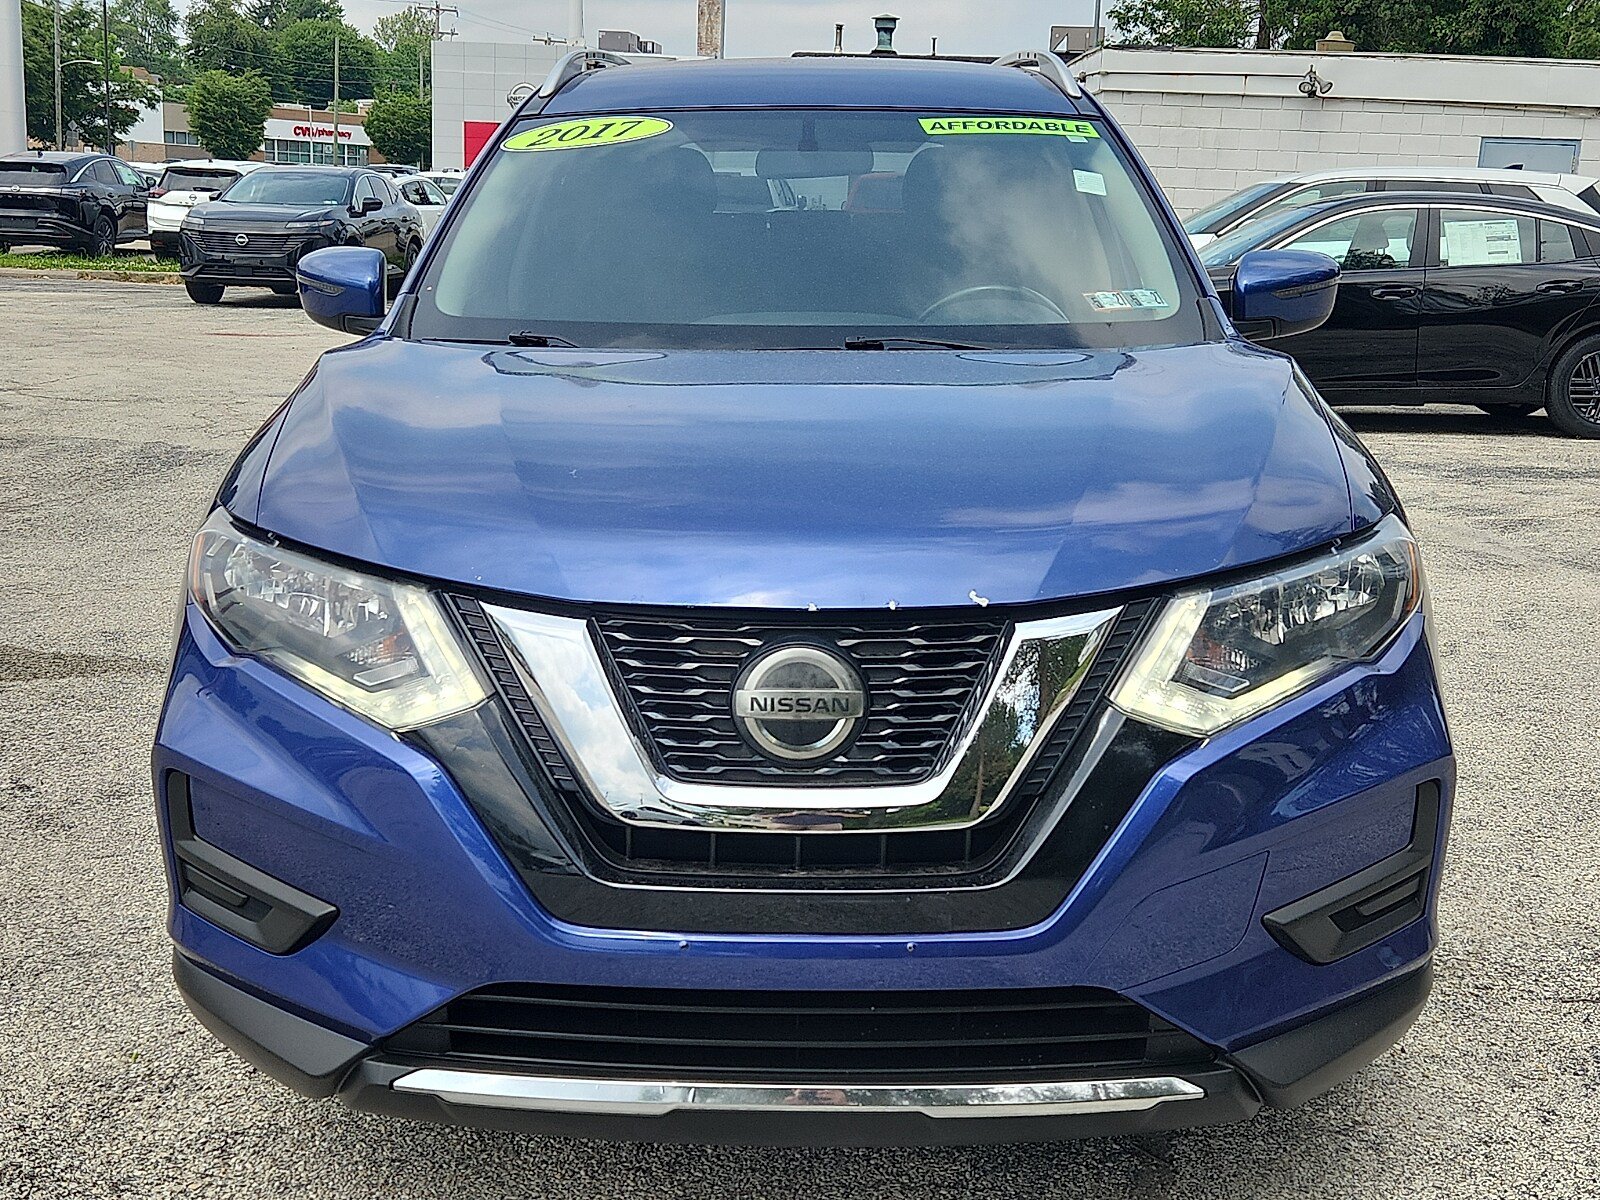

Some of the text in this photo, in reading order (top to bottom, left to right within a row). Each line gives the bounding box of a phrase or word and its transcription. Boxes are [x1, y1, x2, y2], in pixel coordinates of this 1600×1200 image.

[526, 120, 645, 147] 2017
[930, 121, 1092, 134] AFFORDABLE
[750, 697, 849, 712] NISSAN
